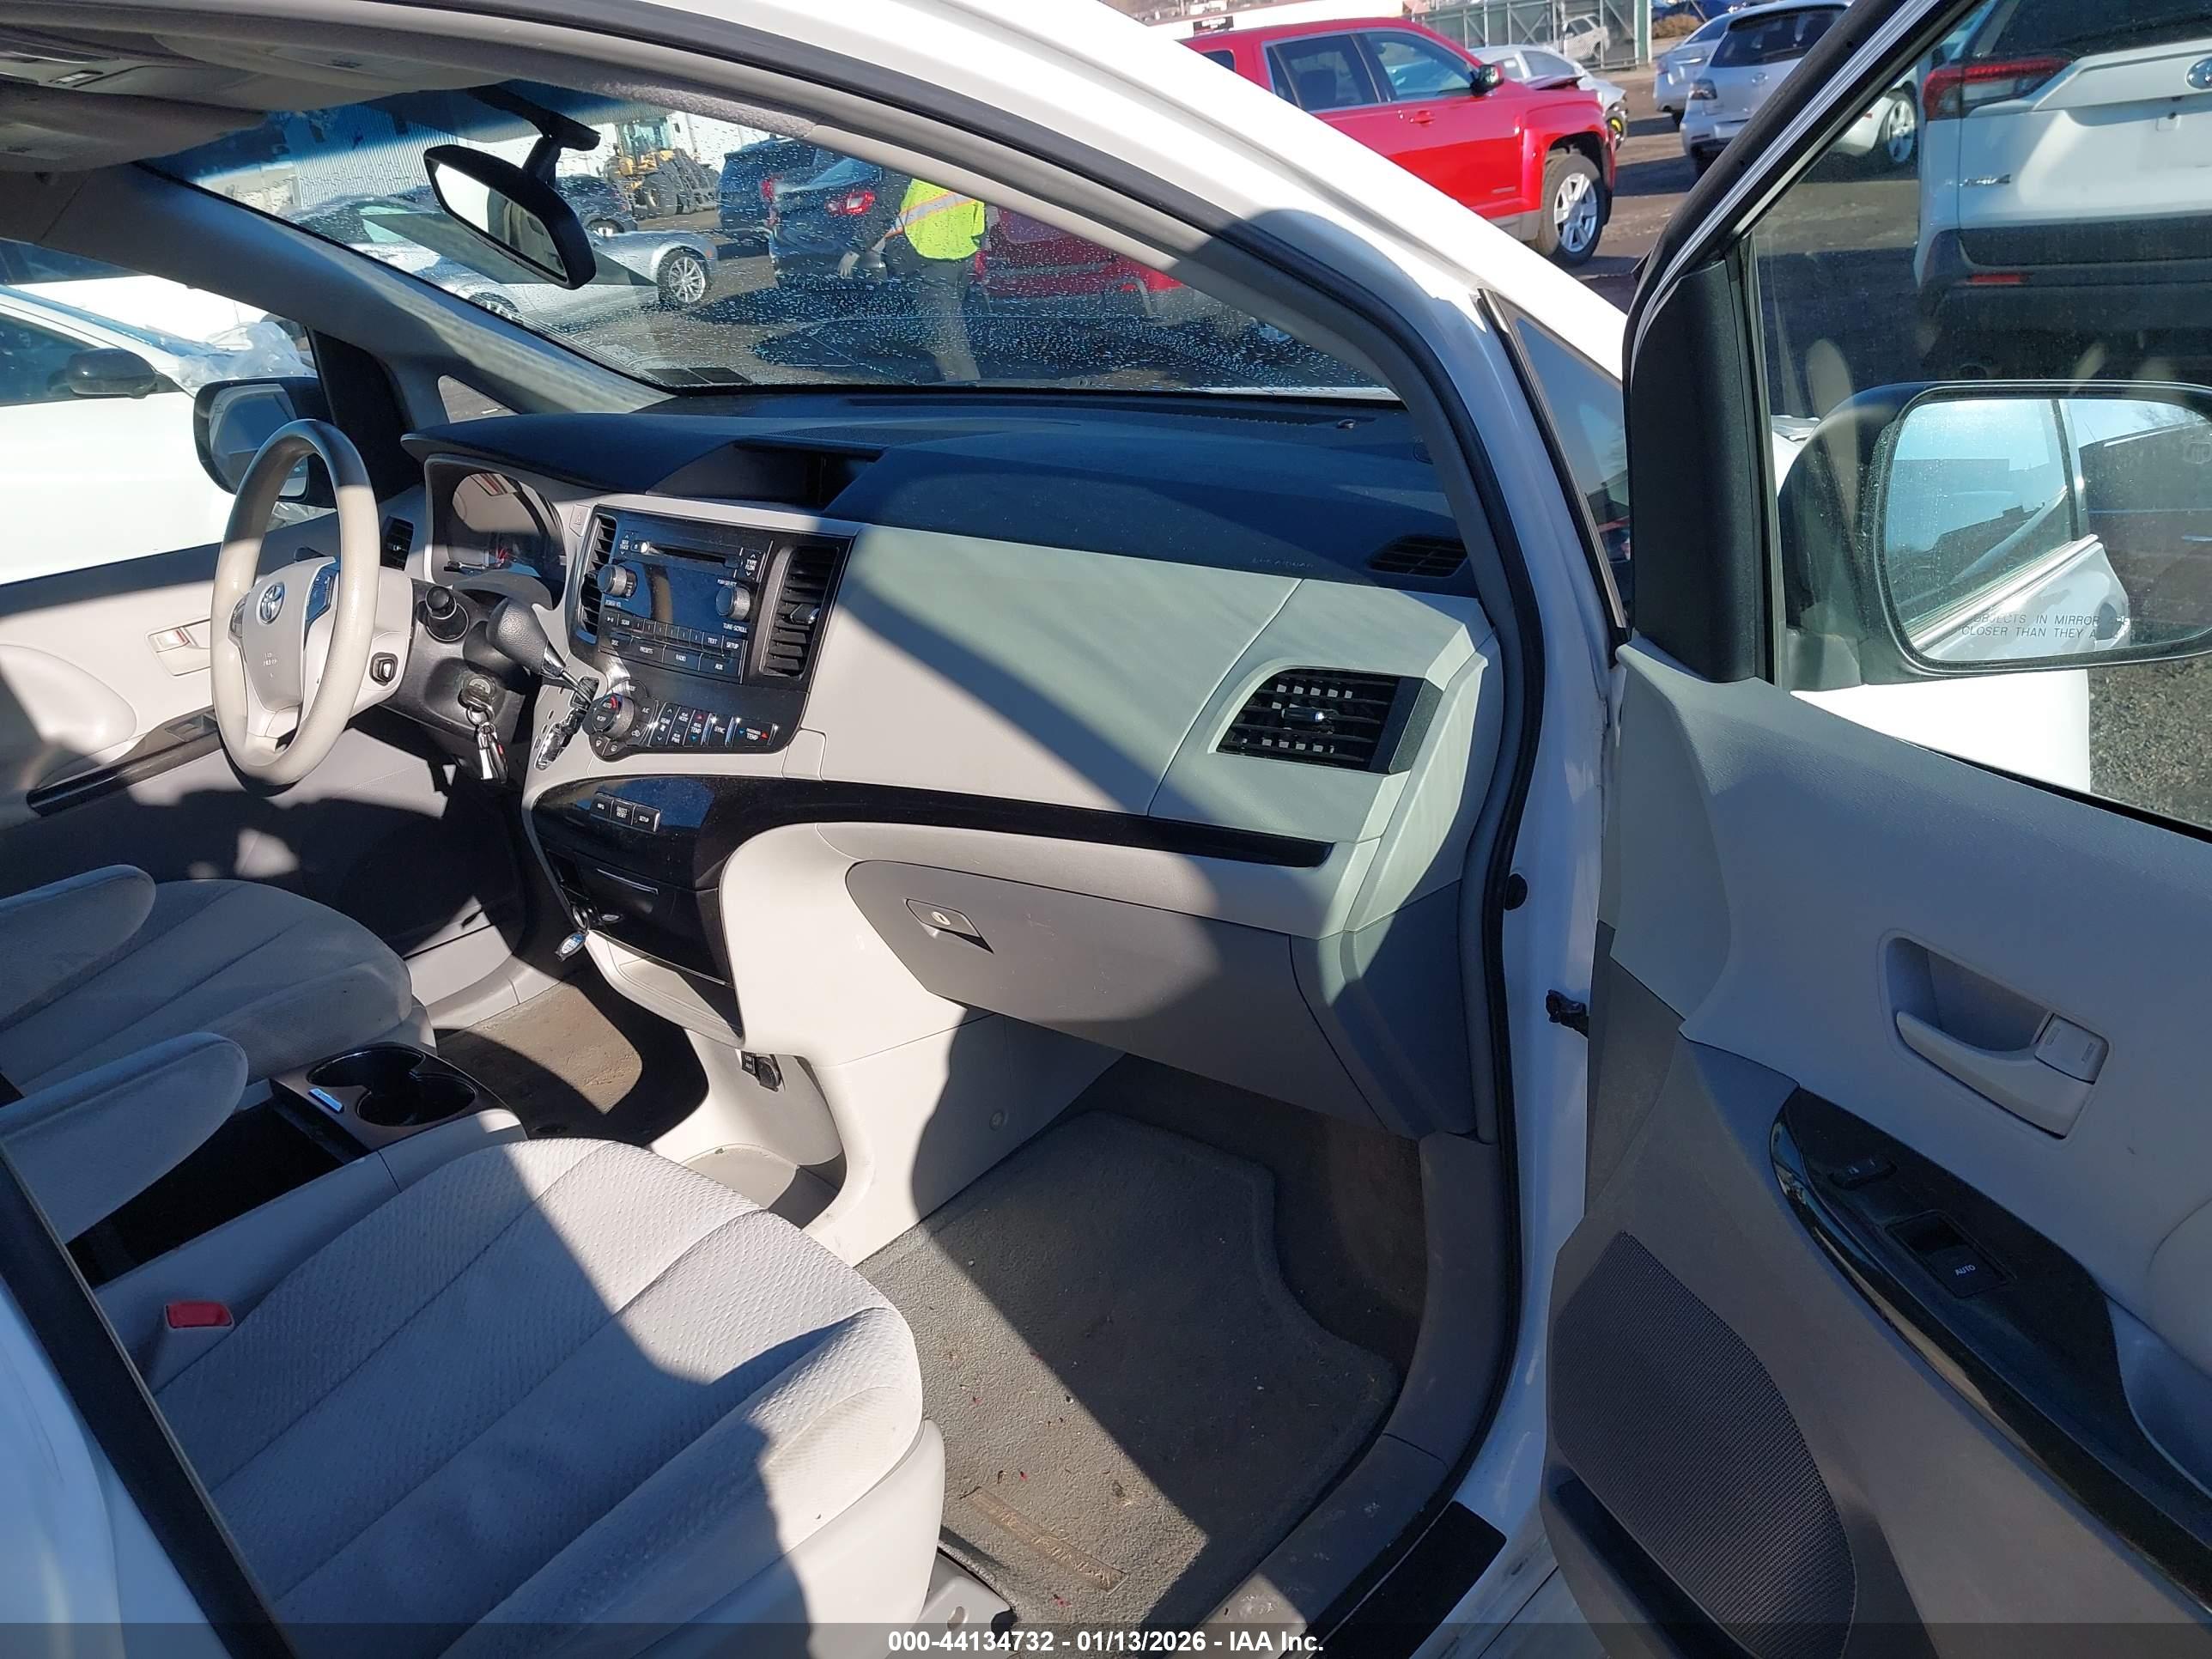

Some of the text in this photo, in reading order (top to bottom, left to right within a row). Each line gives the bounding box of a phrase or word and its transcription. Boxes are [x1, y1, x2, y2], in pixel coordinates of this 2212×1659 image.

[1974, 614, 2027, 624] OBJECTS
[2036, 614, 2048, 624] IN
[2054, 614, 2100, 625] MIRROR
[1961, 625, 2008, 636] CLOSER
[2015, 628, 2048, 637] THAN
[2054, 629, 2083, 638] THEY
[714, 726, 726, 734] SYNC
[1954, 1264, 1976, 1276] AUTO
